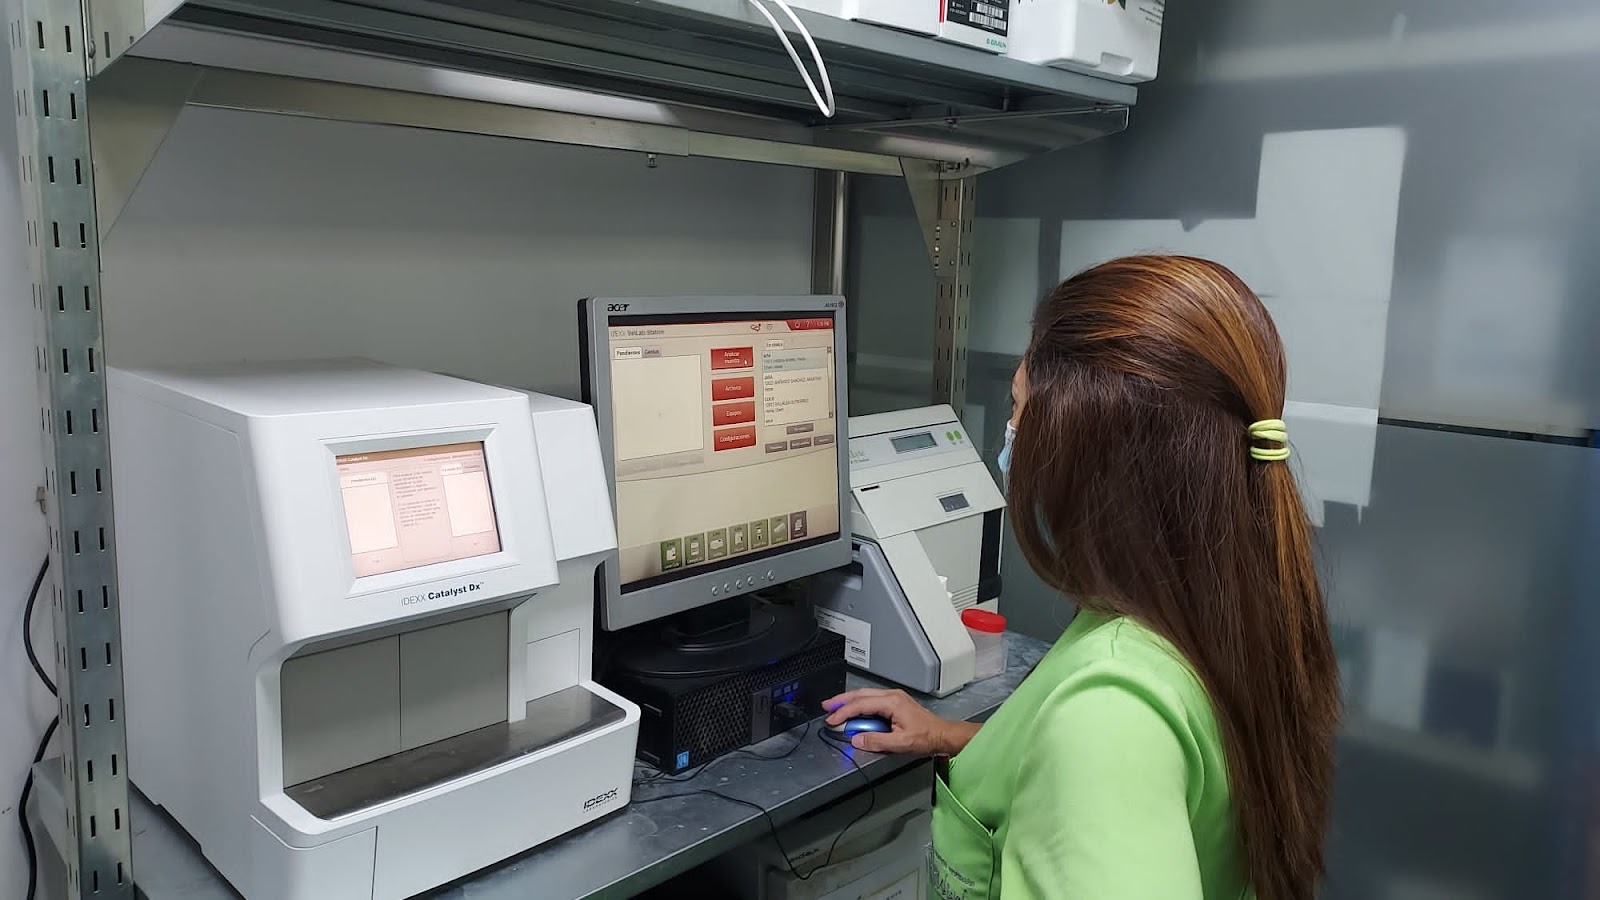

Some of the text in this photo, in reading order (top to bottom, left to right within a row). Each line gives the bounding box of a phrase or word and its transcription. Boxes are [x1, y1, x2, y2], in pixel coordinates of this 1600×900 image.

[607, 303, 630, 312] acer
[401, 594, 426, 607] IDEXX
[427, 586, 467, 600] Catalyst
[583, 788, 618, 809] IDEXX
